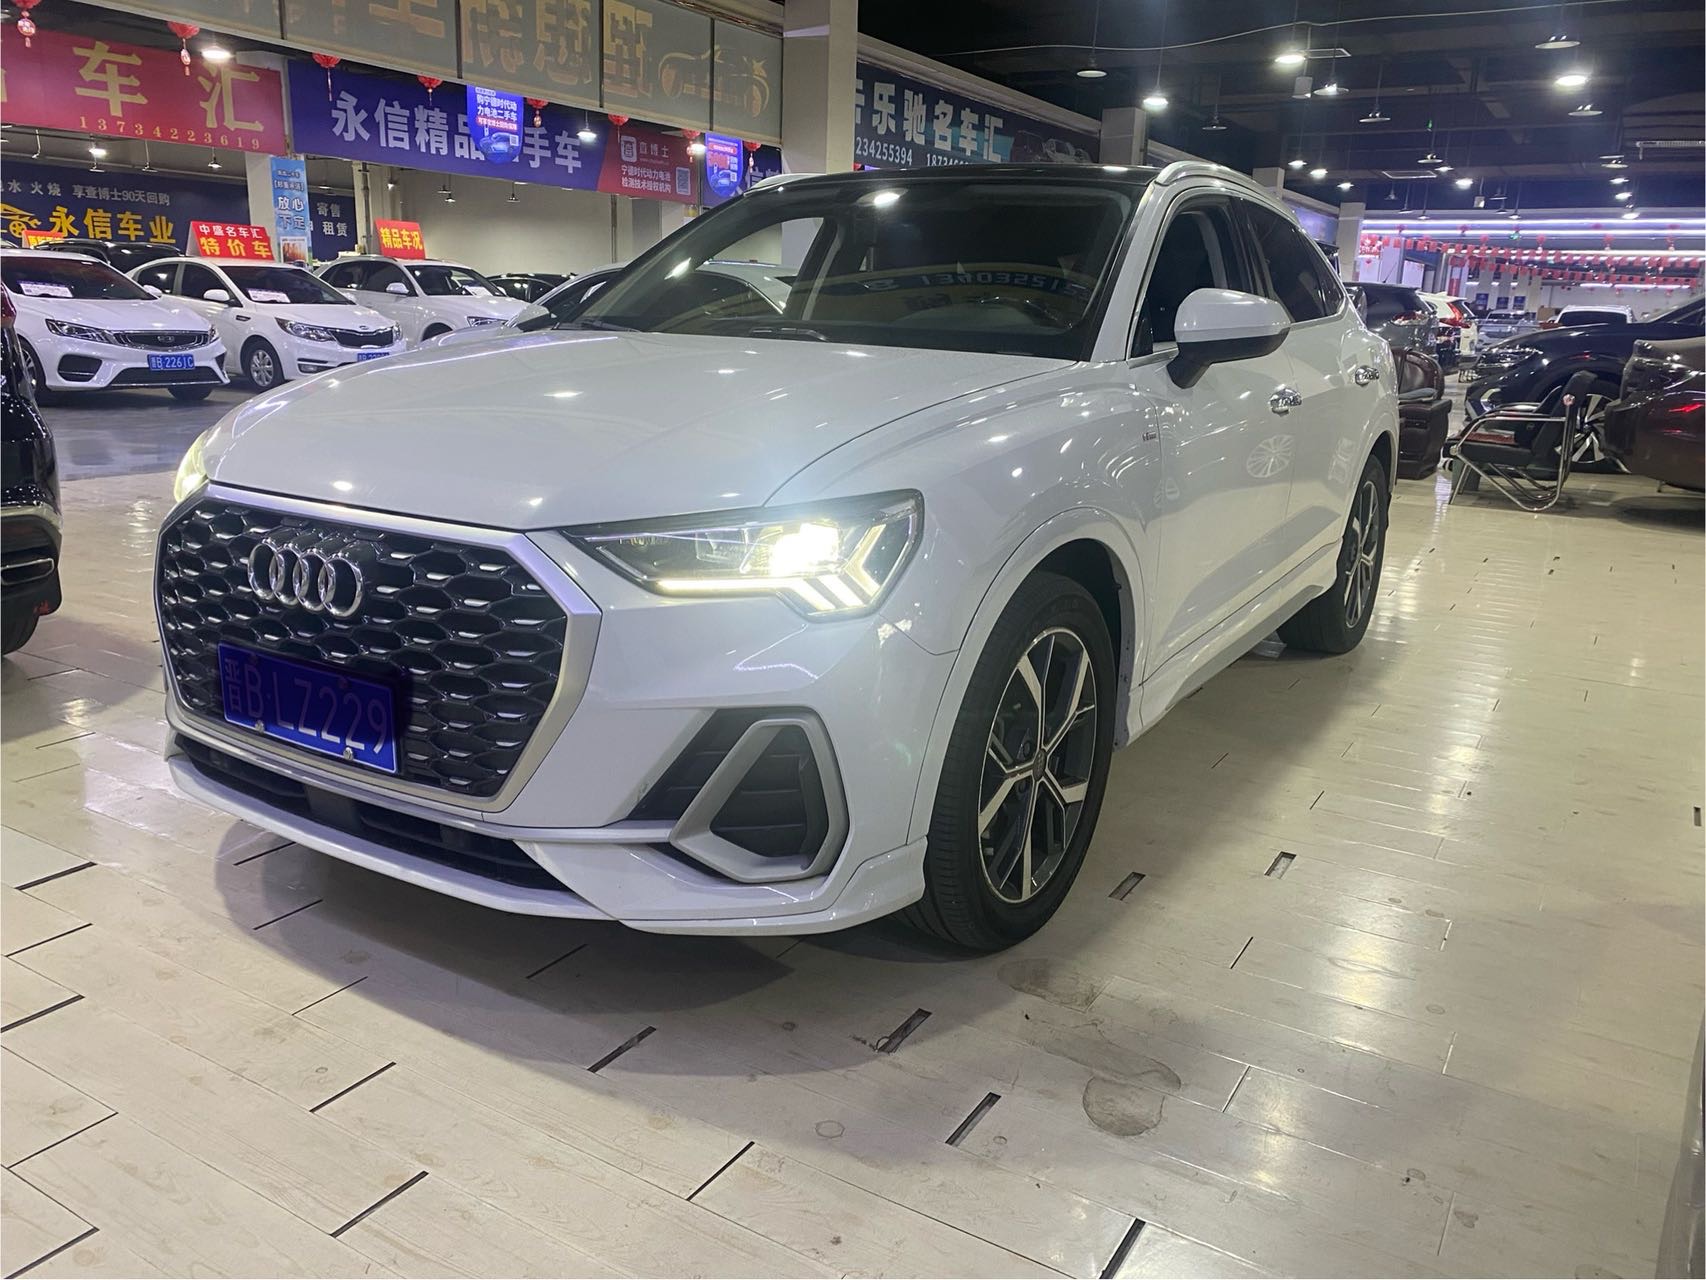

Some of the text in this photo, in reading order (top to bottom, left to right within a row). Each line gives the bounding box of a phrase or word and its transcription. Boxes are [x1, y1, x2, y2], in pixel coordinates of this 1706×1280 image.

[0, 41, 264, 131] 车汇
[80, 116, 260, 149] 13734223619
[331, 90, 582, 174] 永信精品手车
[50, 205, 176, 244] 永信车业
[199, 224, 262, 239] 中盛名车汇
[322, 221, 348, 236] 租赁
[380, 227, 423, 250] 精品车况
[200, 237, 271, 258] 特价车
